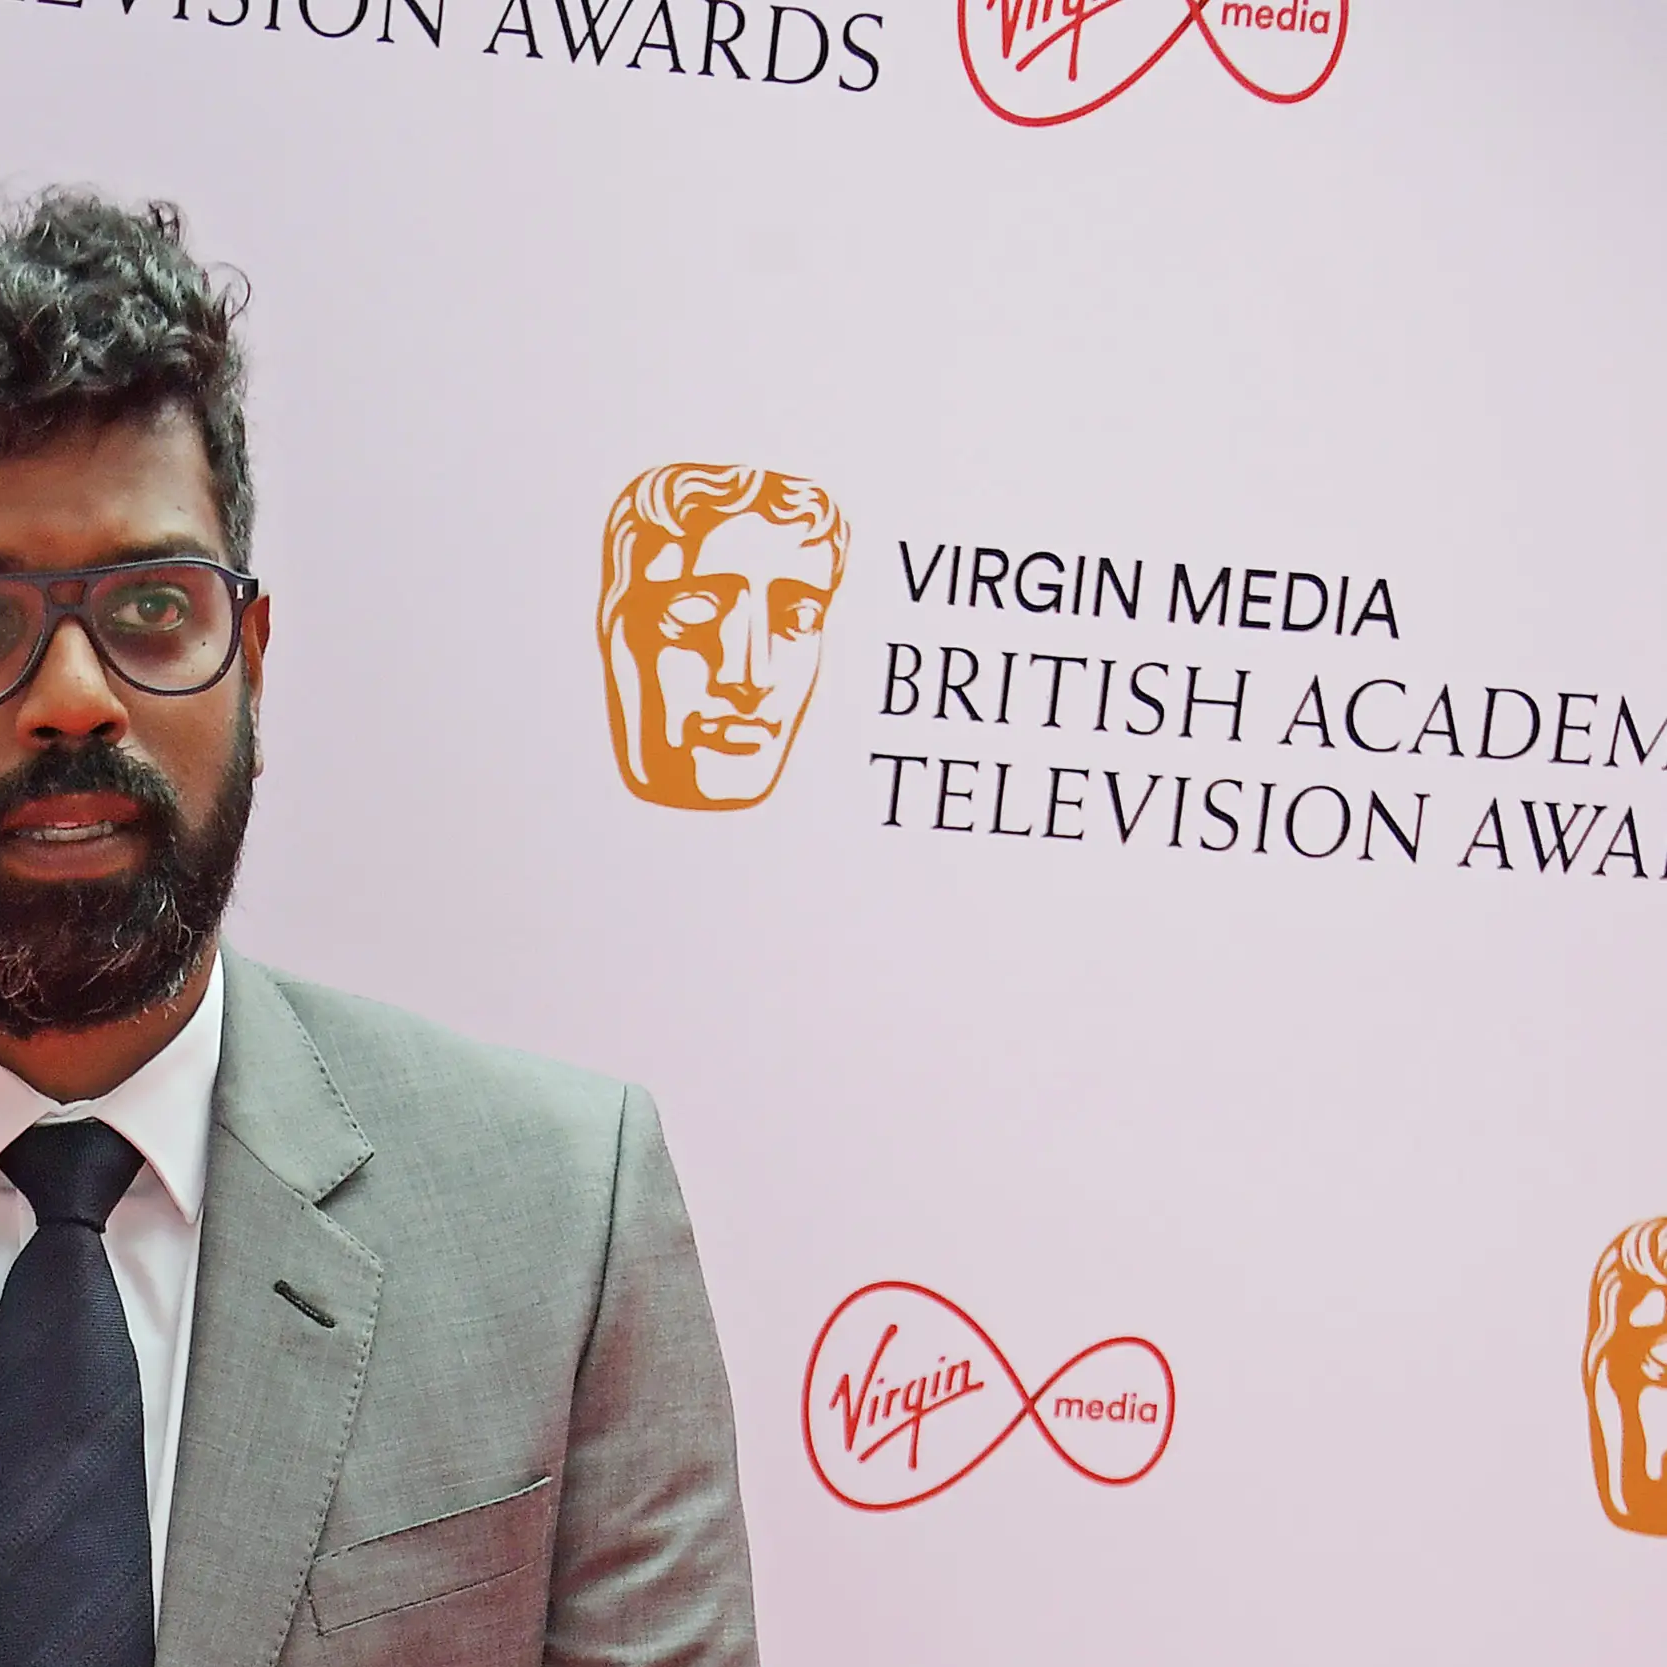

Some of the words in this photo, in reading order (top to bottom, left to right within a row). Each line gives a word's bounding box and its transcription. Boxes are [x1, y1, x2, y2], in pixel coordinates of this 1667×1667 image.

[483, 0, 883, 92] AWARDS
[1221, 0, 1330, 34] media
[898, 541, 1143, 620] VIRGIN
[1168, 563, 1399, 640] MEDIA
[879, 643, 1251, 742] BRITISH
[1277, 675, 1667, 771] ACADEM
[869, 753, 1431, 863] TELEVISION
[1457, 797, 1667, 880] AWA
[829, 1324, 984, 1471] Virgin
[1054, 1393, 1157, 1424] media
